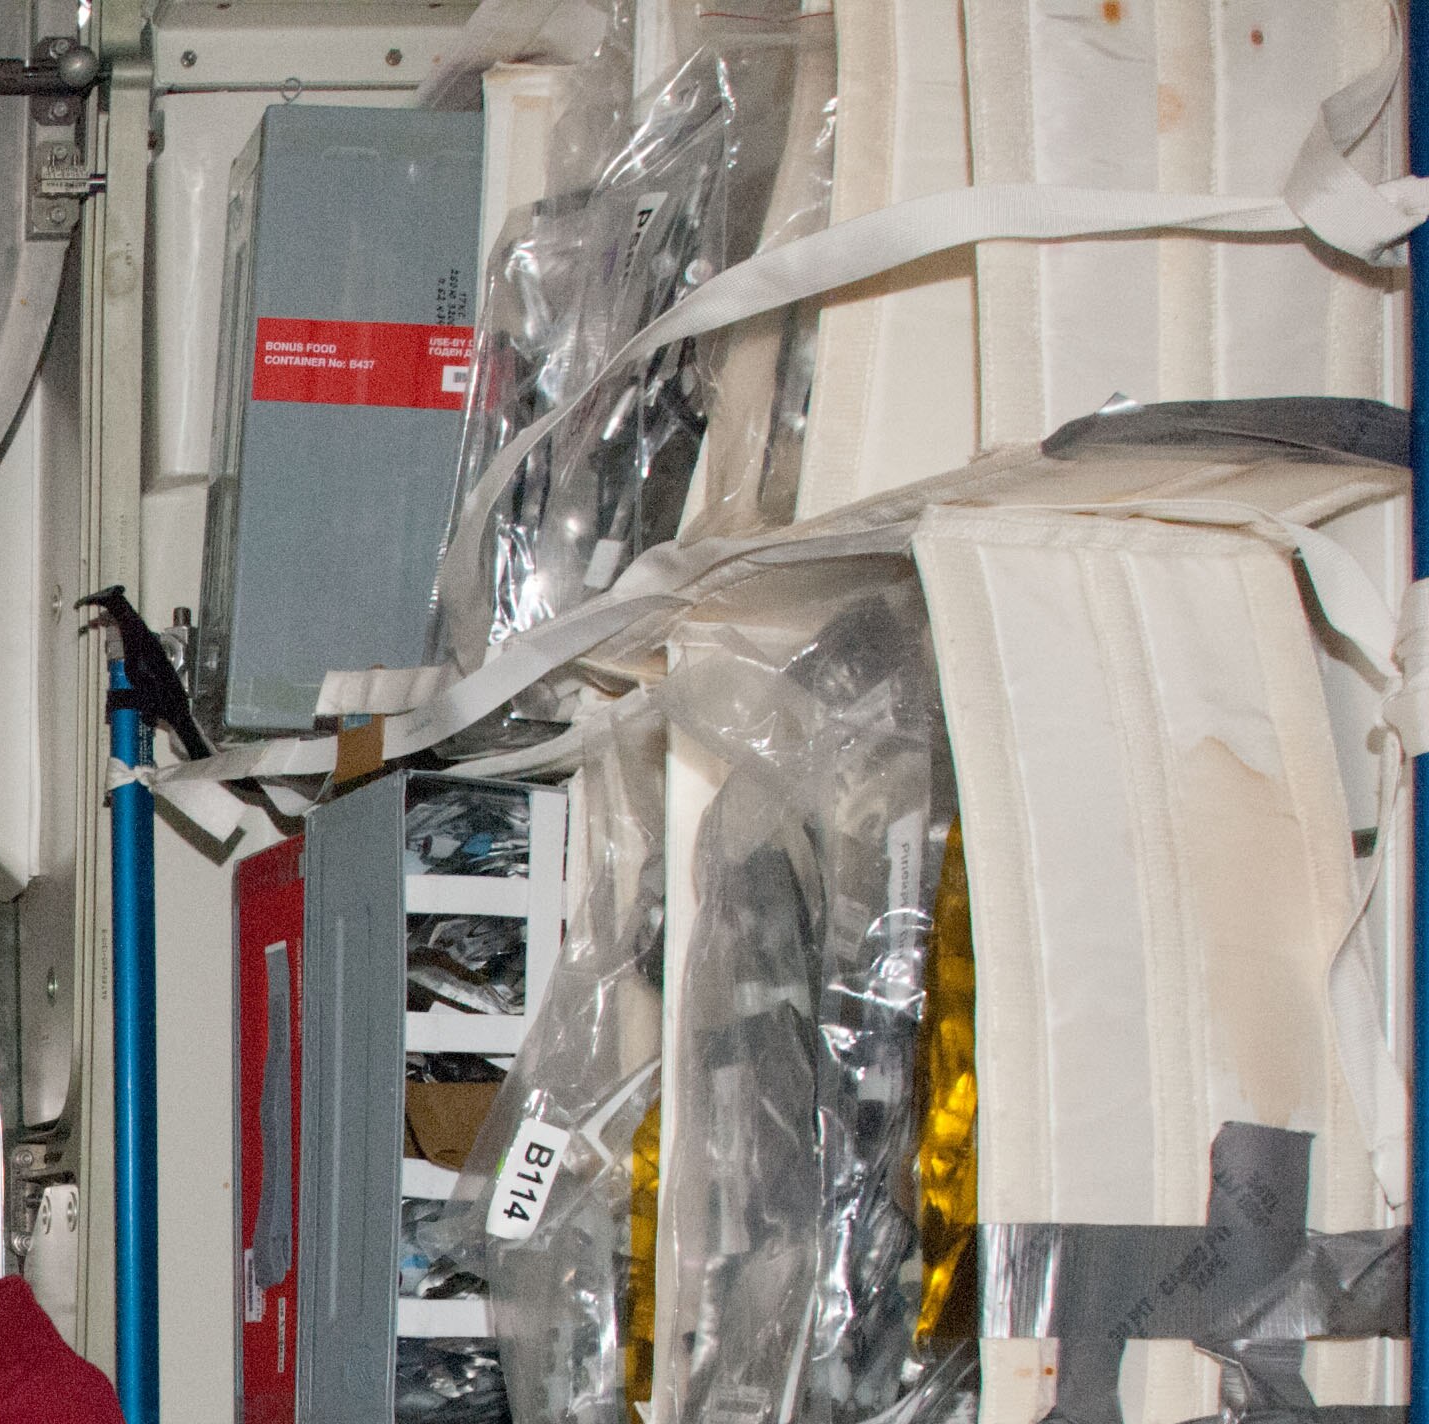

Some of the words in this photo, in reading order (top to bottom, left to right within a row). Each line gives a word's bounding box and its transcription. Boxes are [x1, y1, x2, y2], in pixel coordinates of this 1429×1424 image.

[265, 341, 303, 352] BONUS
[306, 343, 337, 353] FOOD
[429, 337, 466, 347] USE-BY
[264, 355, 326, 367] CONTAINER
[328, 358, 346, 368] No:
[349, 359, 374, 369] B437
[499, 1140, 555, 1221] B114
